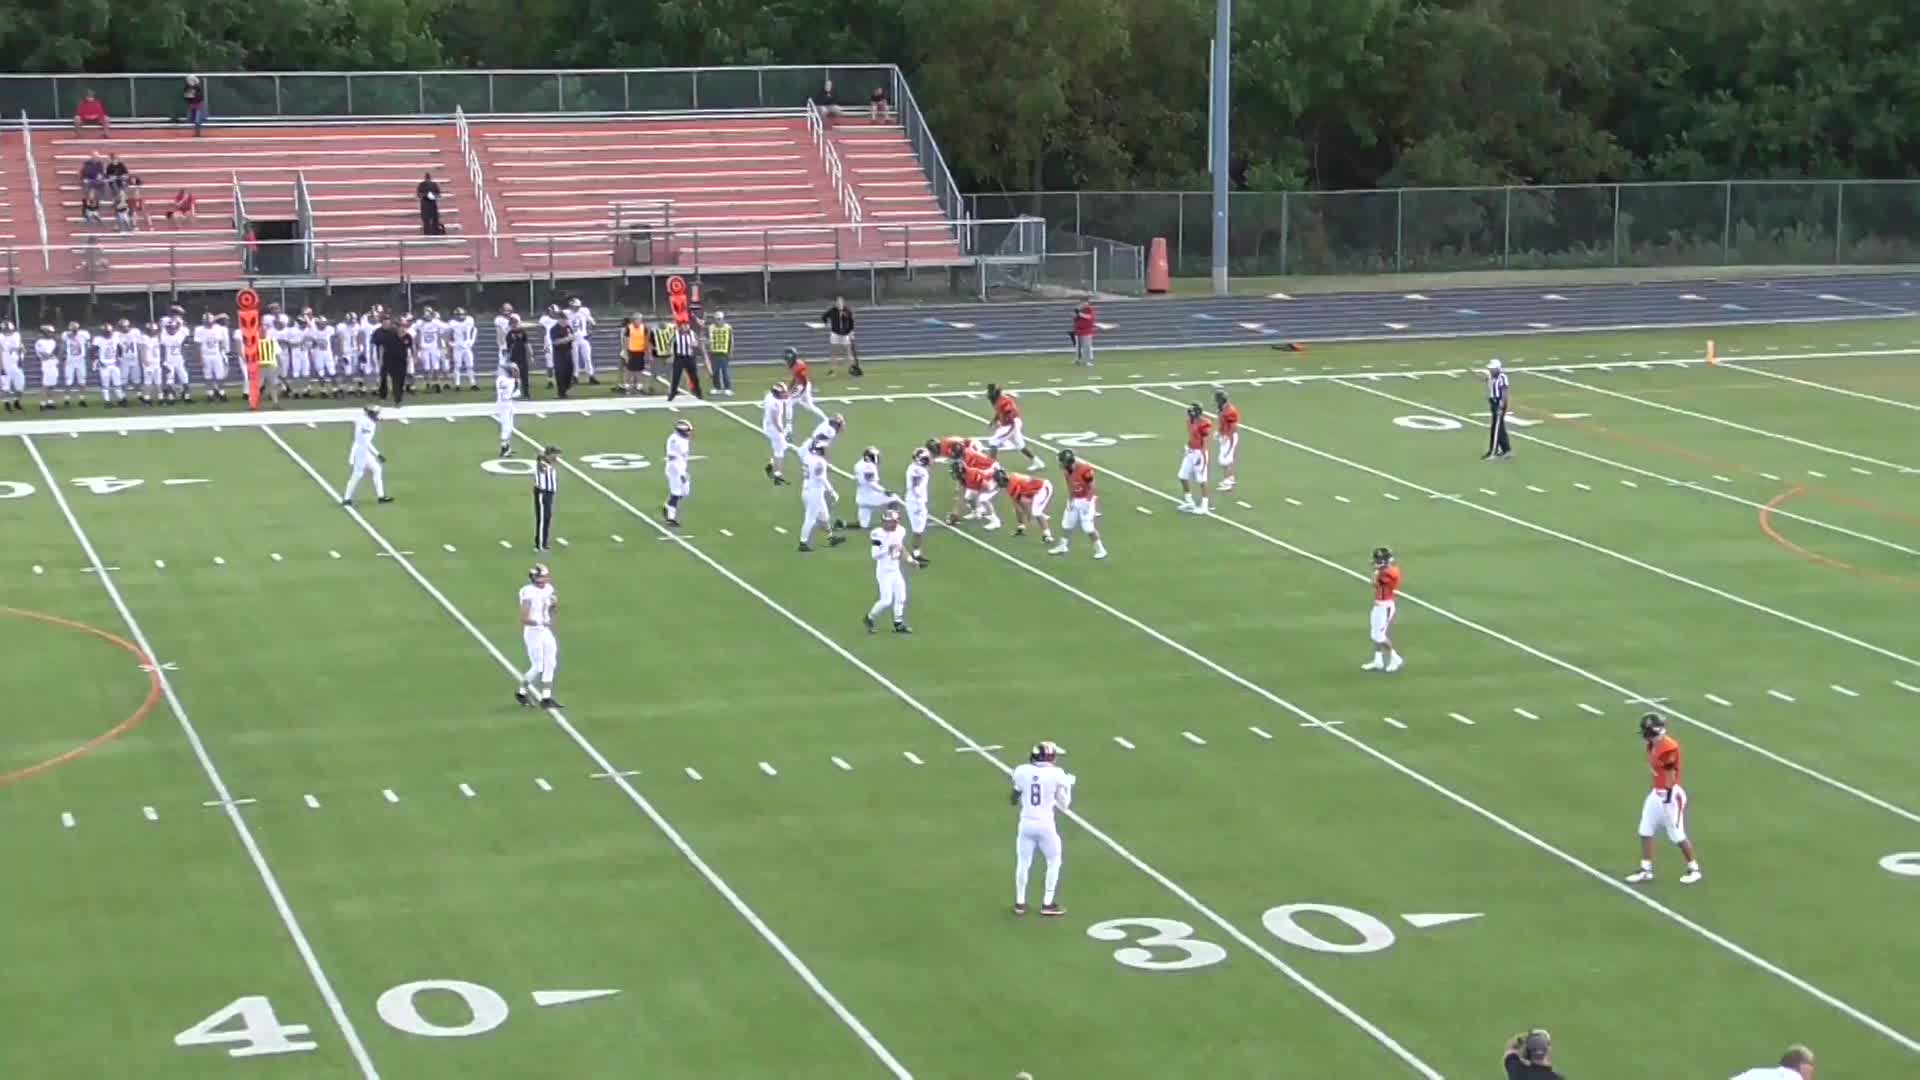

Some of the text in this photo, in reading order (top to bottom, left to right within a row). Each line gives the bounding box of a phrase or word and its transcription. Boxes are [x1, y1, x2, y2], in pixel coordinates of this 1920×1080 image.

[1030, 783, 1041, 806] 8
[1086, 903, 1396, 969] 30
[174, 979, 509, 1056] 40
